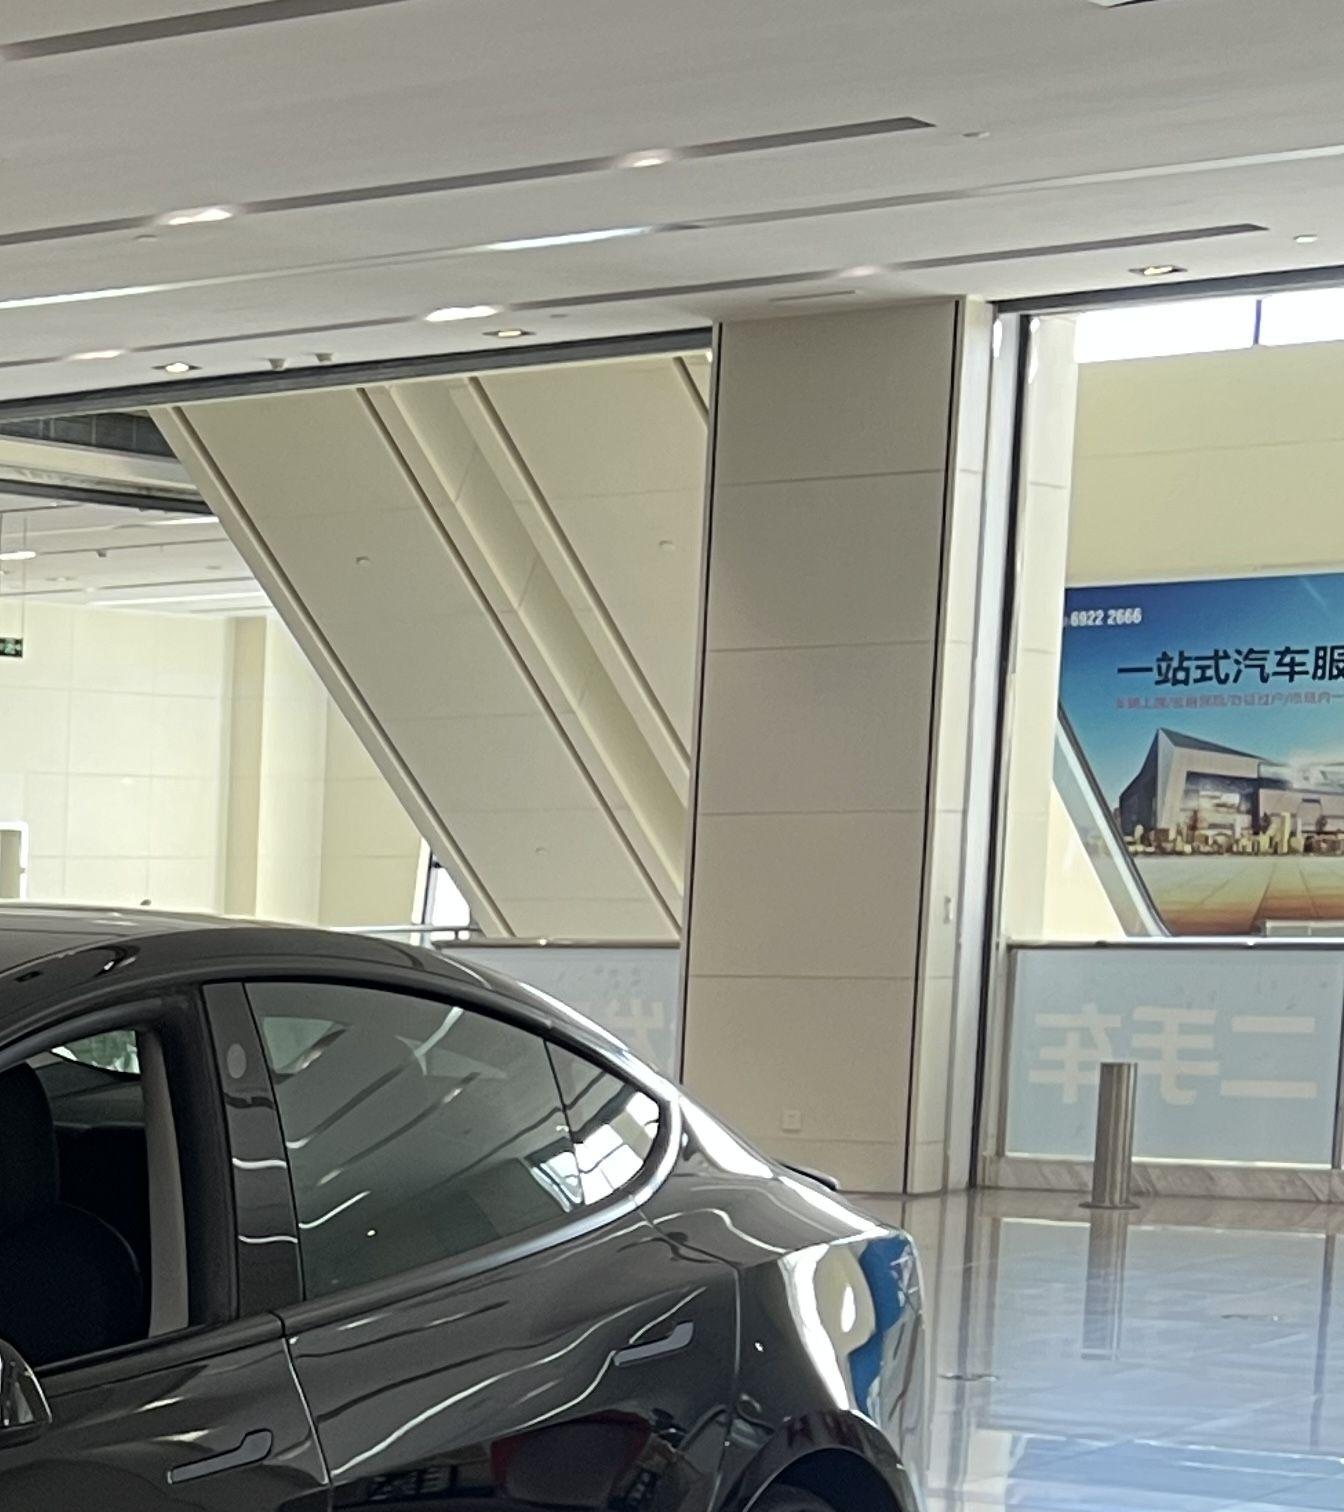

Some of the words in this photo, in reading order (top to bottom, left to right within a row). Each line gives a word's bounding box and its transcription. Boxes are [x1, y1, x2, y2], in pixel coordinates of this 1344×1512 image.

[1117, 645, 1344, 686] 一站式汽车服
